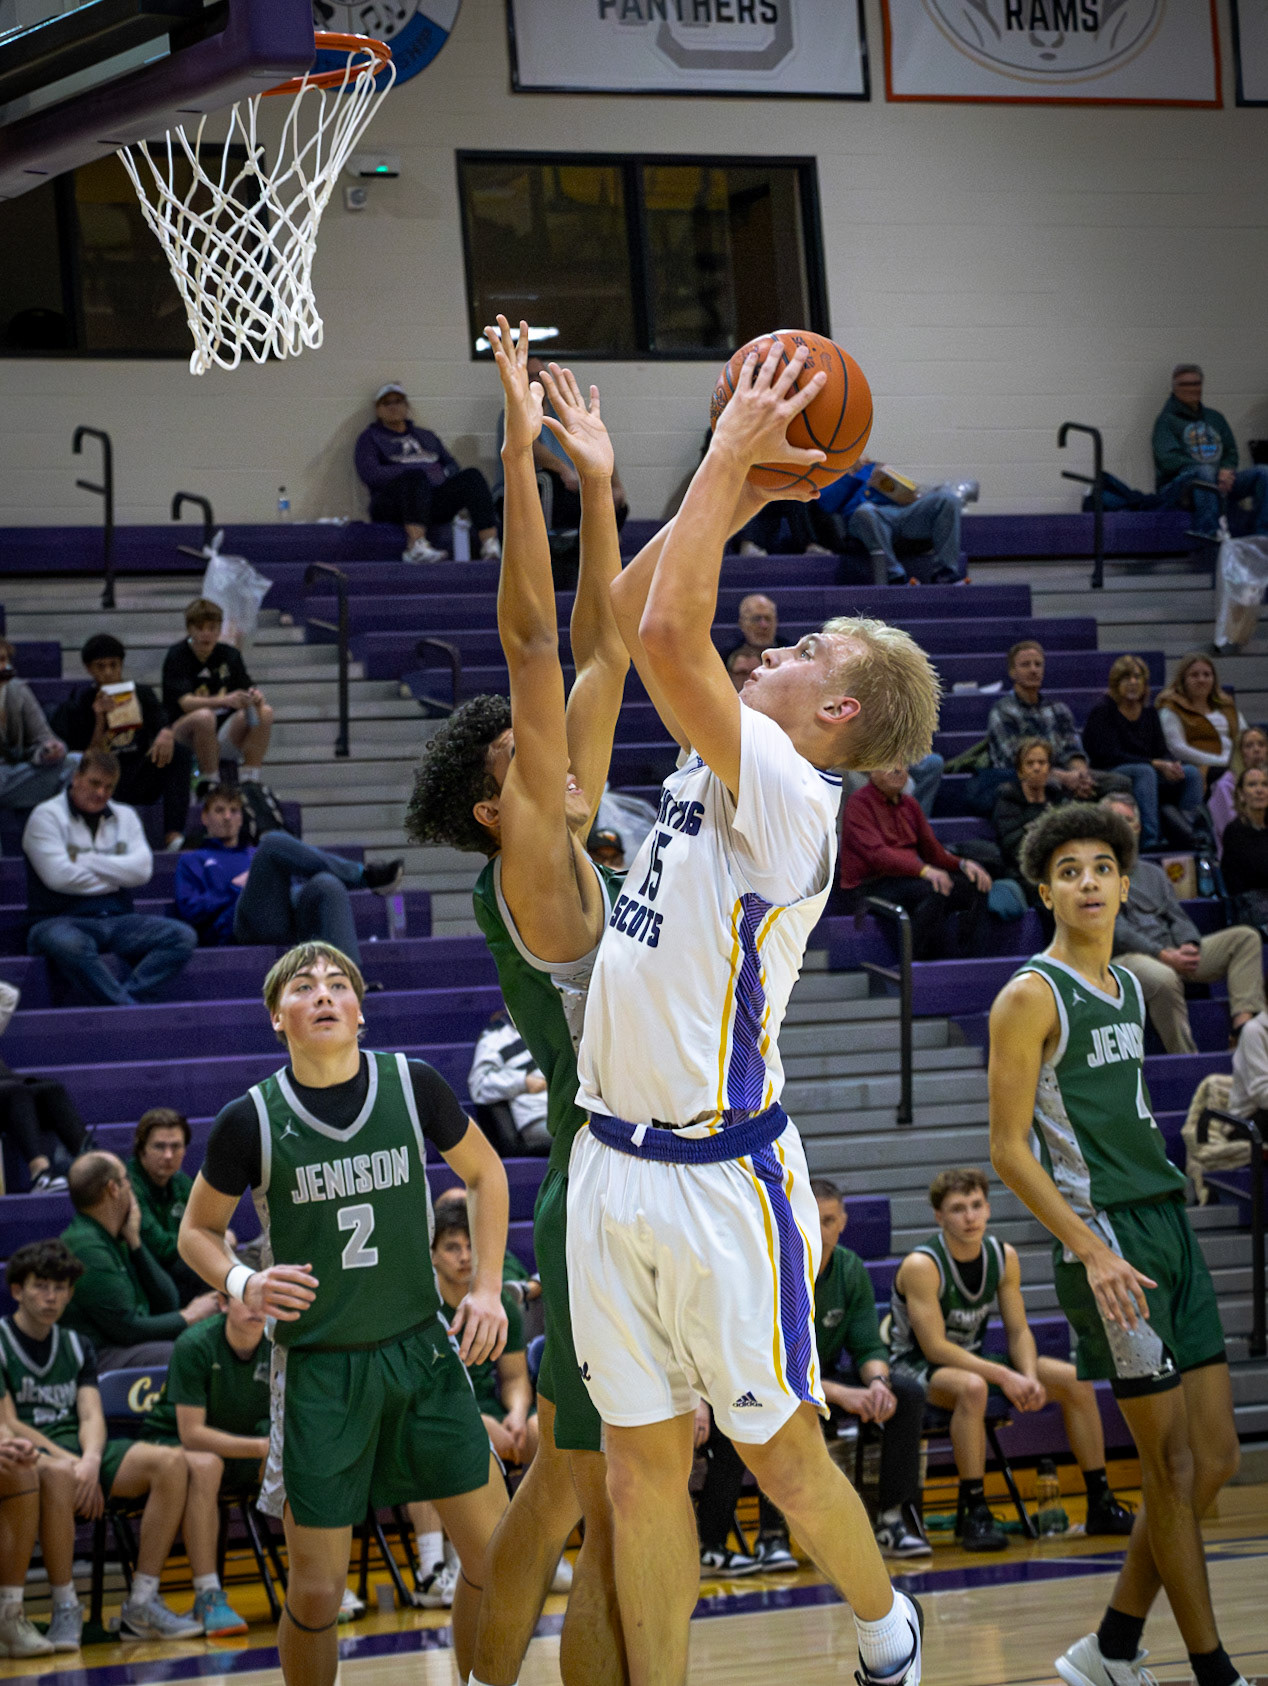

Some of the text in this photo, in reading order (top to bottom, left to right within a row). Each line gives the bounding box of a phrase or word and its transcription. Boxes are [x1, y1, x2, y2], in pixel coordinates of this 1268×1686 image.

[598, 0, 777, 24] PANTHERS
[1006, 0, 1099, 32] RAMS
[638, 829, 672, 901] 15
[609, 894, 664, 948] SCOTS
[291, 1146, 409, 1204] JENISON
[337, 1203, 378, 1269] 2
